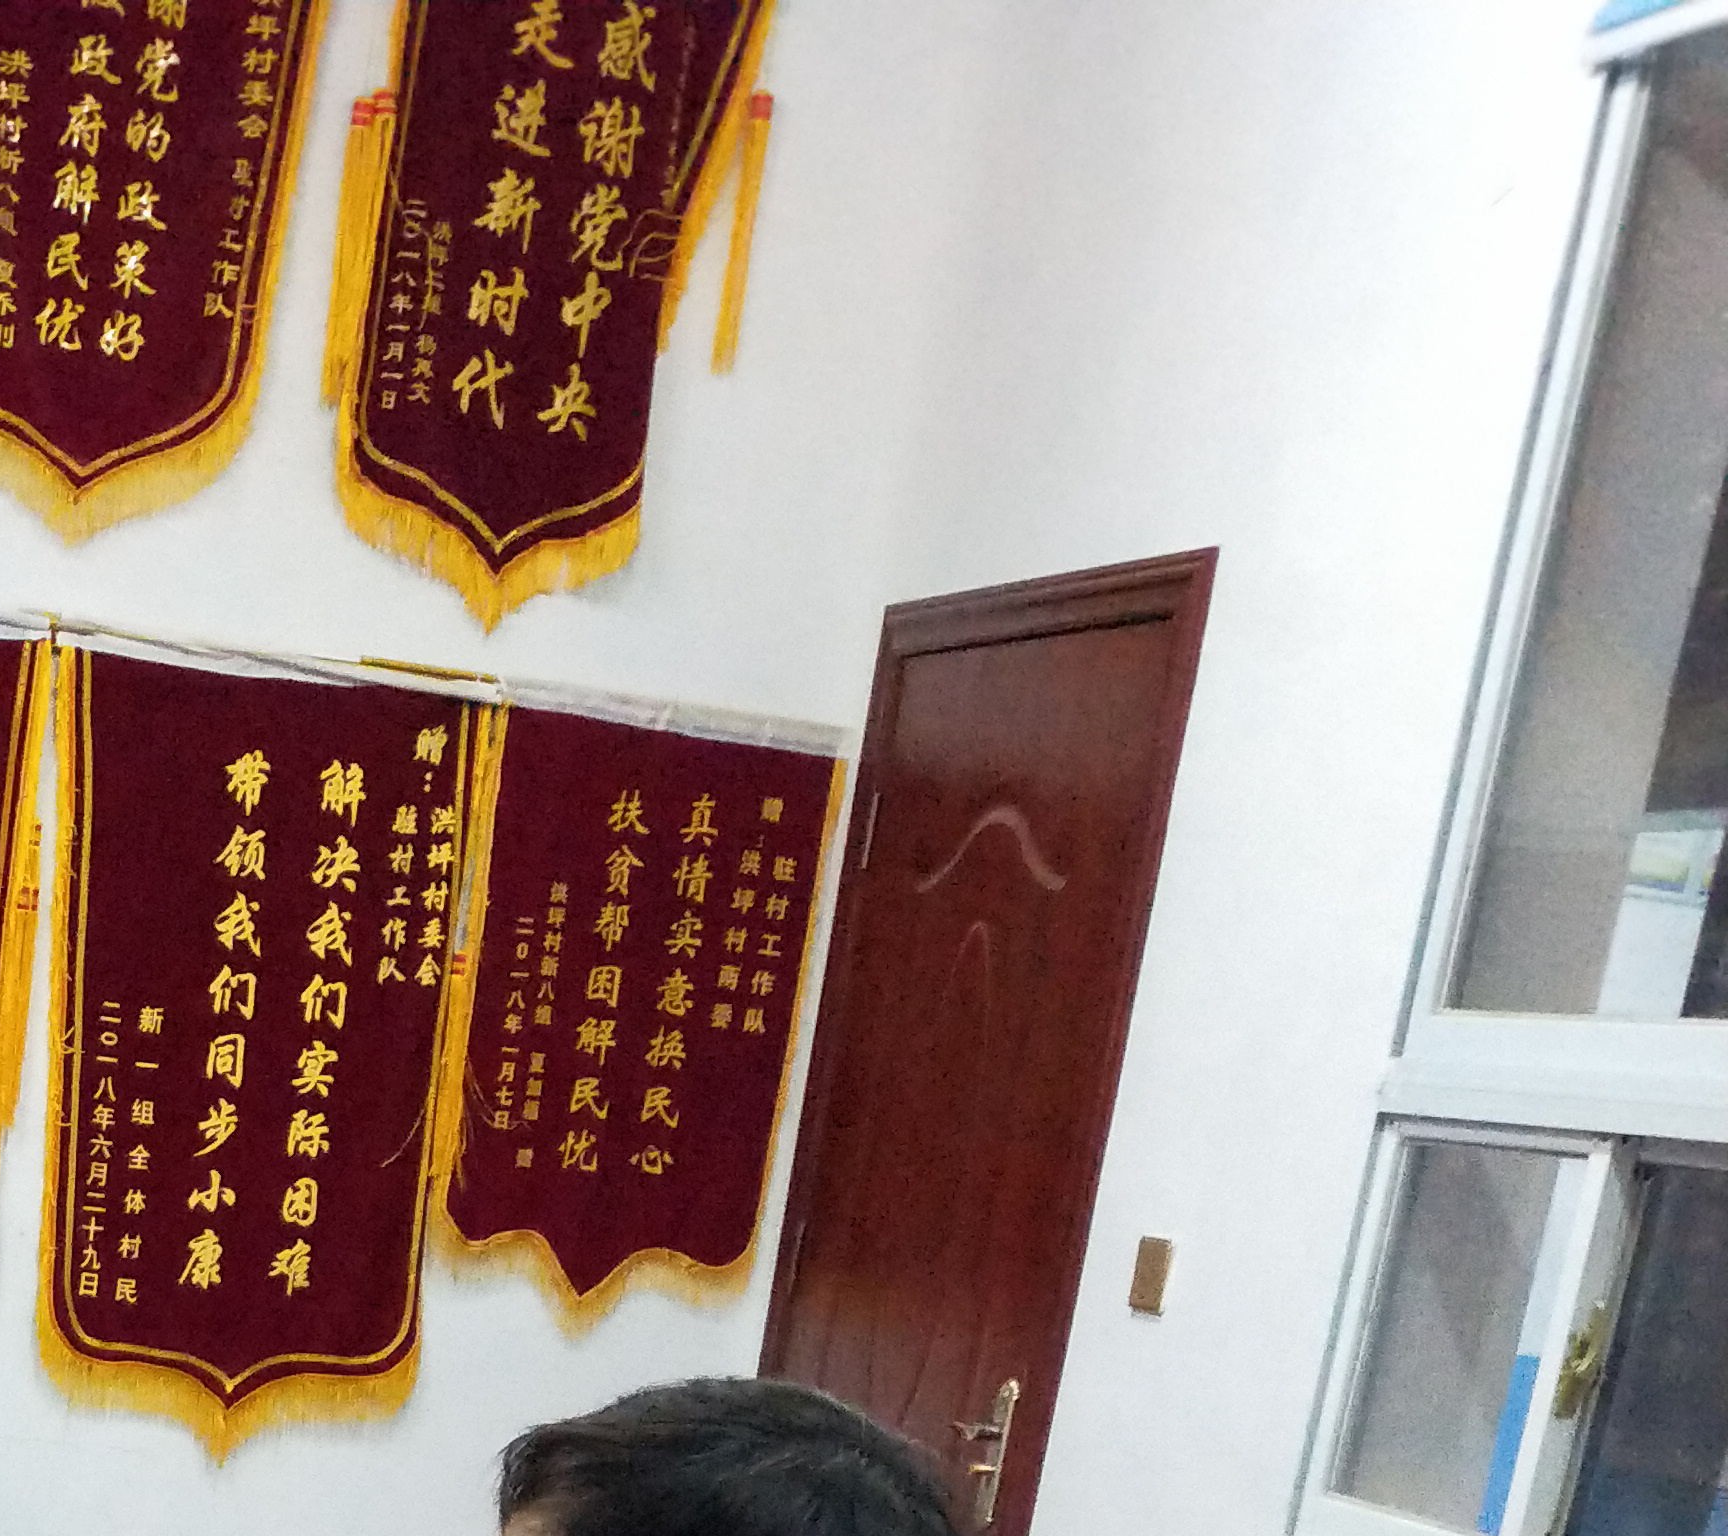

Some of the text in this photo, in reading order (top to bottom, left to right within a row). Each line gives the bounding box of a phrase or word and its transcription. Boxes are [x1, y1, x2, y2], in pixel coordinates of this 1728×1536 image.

[34, 0, 127, 352] 政府解民优
[237, 0, 282, 139] 坪村委会
[537, 1, 657, 442] 感谢党中央
[177, 748, 272, 1291] 带领我们同步小康
[269, 758, 368, 1297] 解决我们实际困难
[376, 802, 420, 985] 驻村工作队
[414, 805, 457, 988] 洪坪村委会
[556, 789, 651, 1173] 扶贫帮困解民忧
[629, 792, 720, 1176] 真情实意换民心
[78, 1000, 122, 1299] 二〇一八年六月二十九日
[114, 1006, 165, 1304] 新一组全体村民
